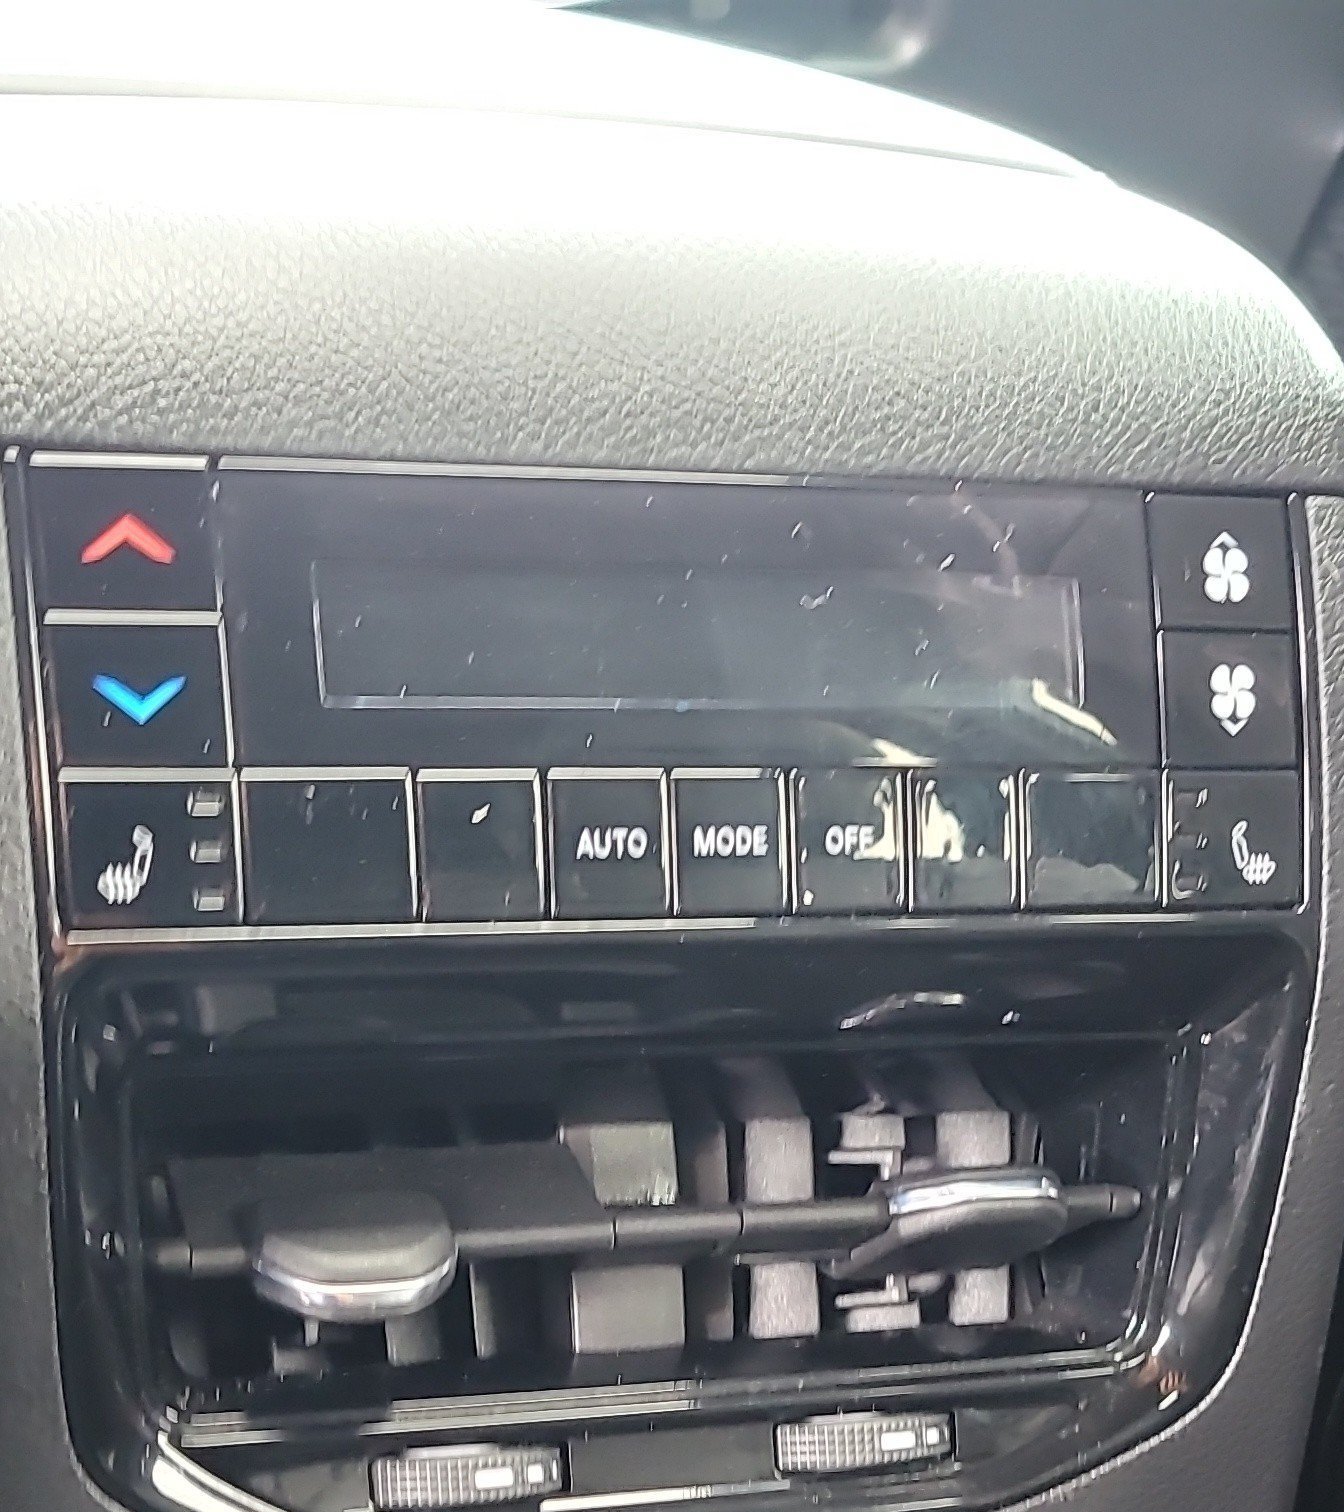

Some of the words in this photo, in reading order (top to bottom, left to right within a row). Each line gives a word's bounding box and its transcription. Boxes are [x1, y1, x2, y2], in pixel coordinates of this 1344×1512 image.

[575, 825, 648, 860] AUTO
[693, 825, 769, 858] MODE
[824, 825, 876, 858] OFF
